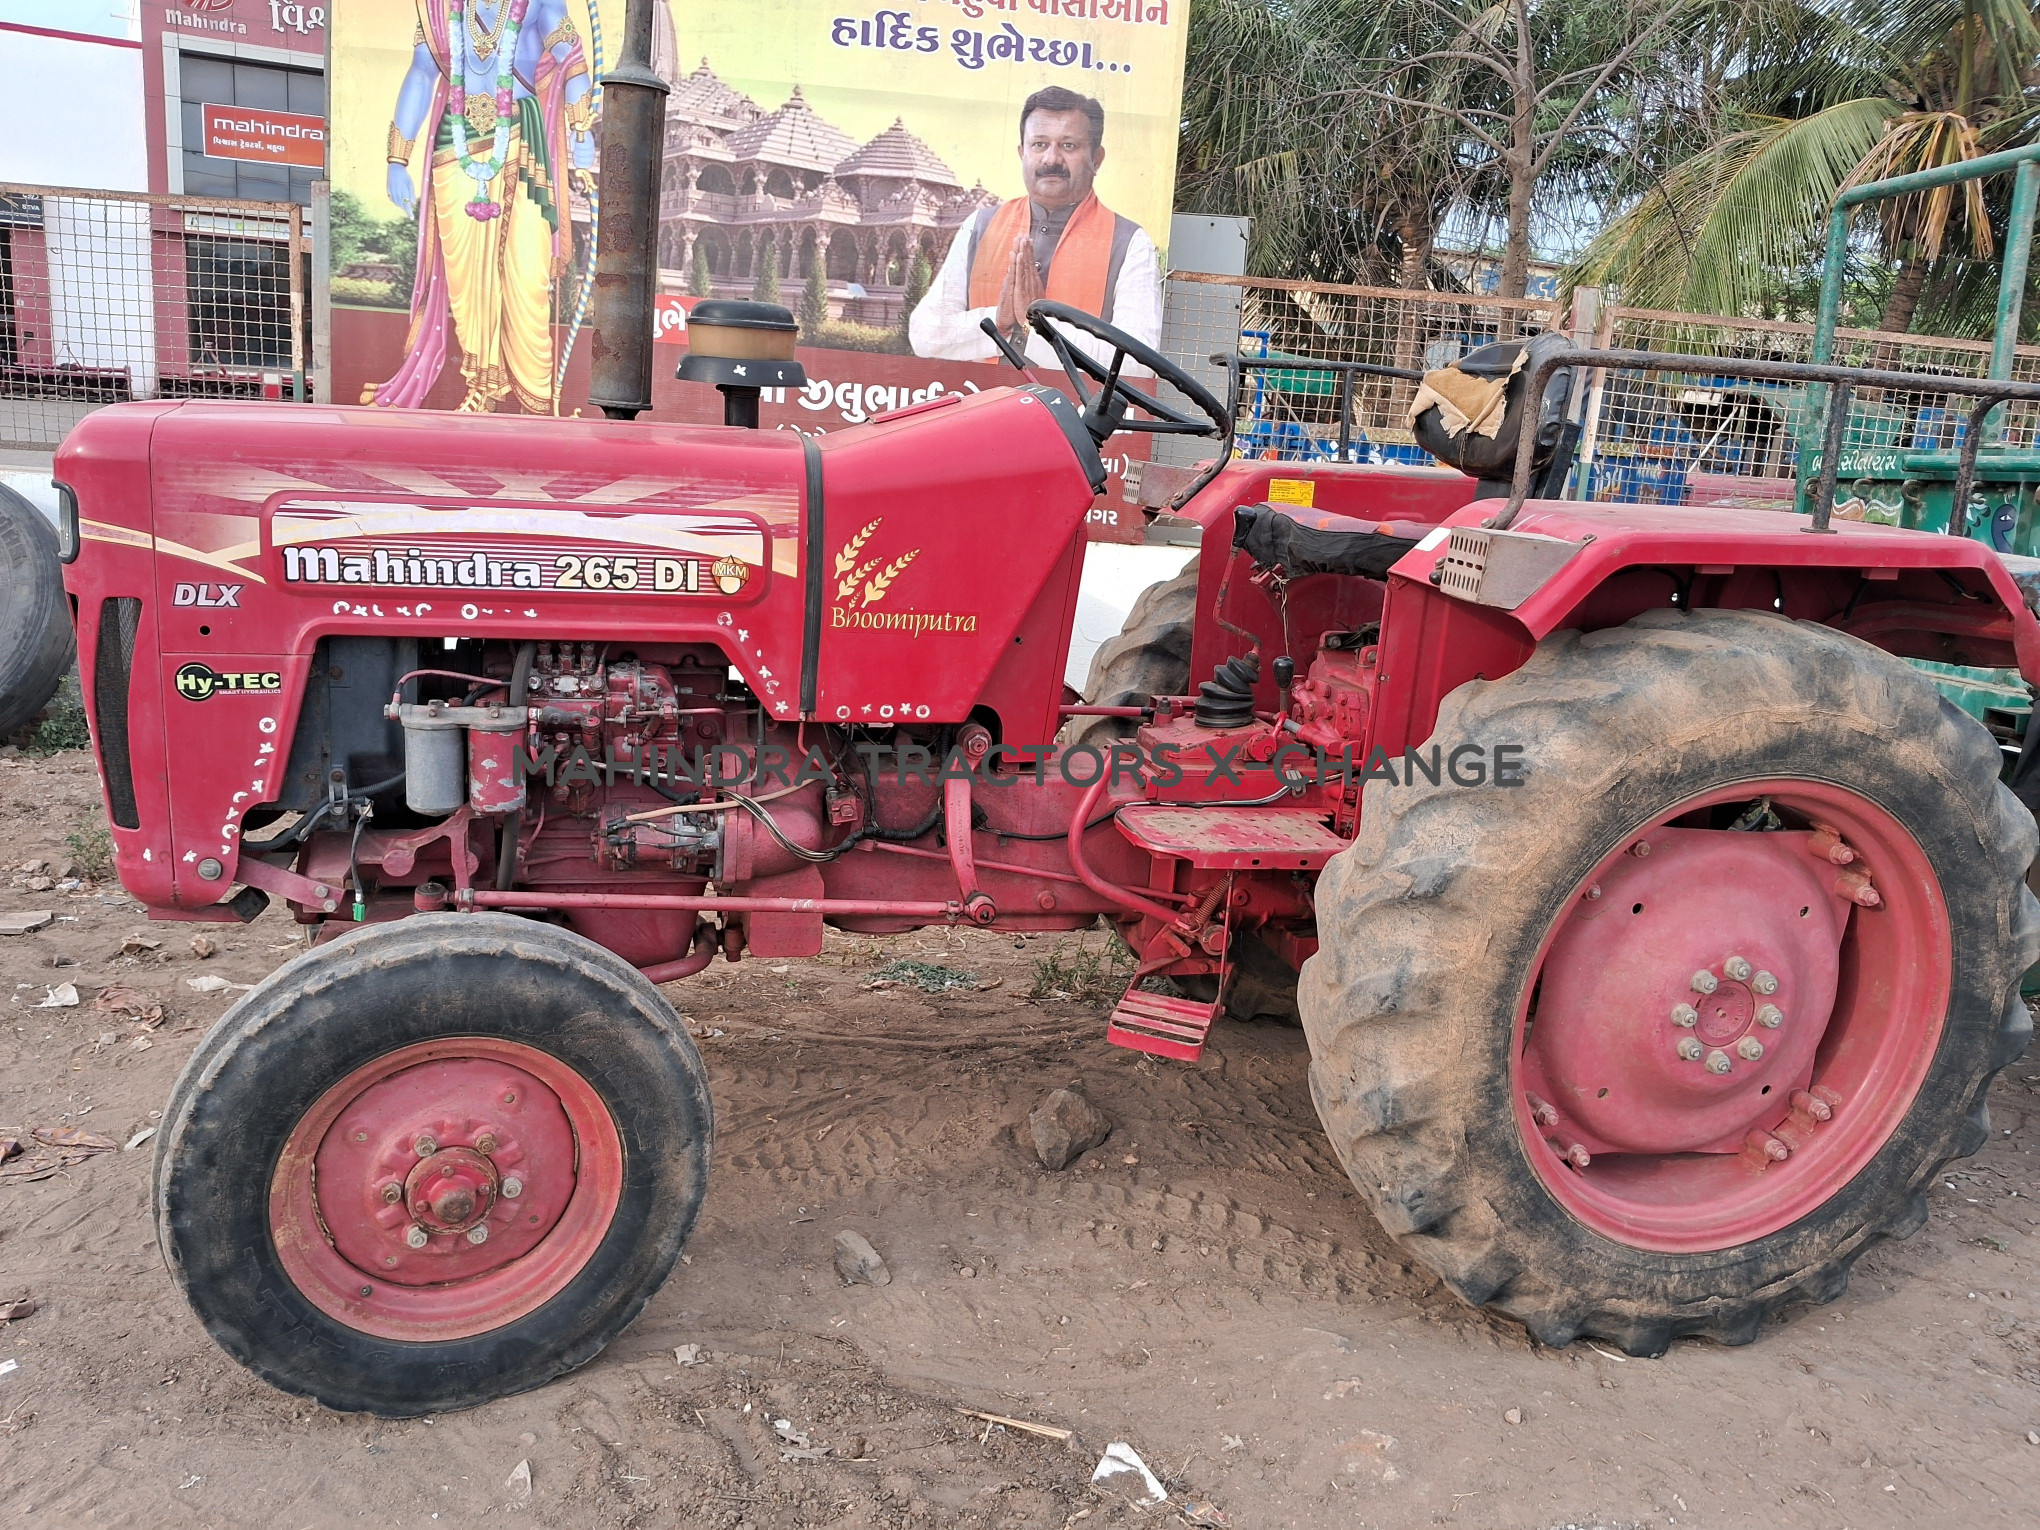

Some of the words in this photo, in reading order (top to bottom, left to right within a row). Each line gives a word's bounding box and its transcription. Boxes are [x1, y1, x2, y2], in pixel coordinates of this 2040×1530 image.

[213, 117, 325, 141] mahindra
[283, 546, 542, 588] Mahindra
[553, 554, 640, 591] 265
[653, 558, 700, 592] DI
[714, 561, 748, 579] MKM
[172, 583, 244, 608] DLX
[829, 606, 978, 638] Bhoomiputra
[176, 672, 281, 695] Hy-TEC
